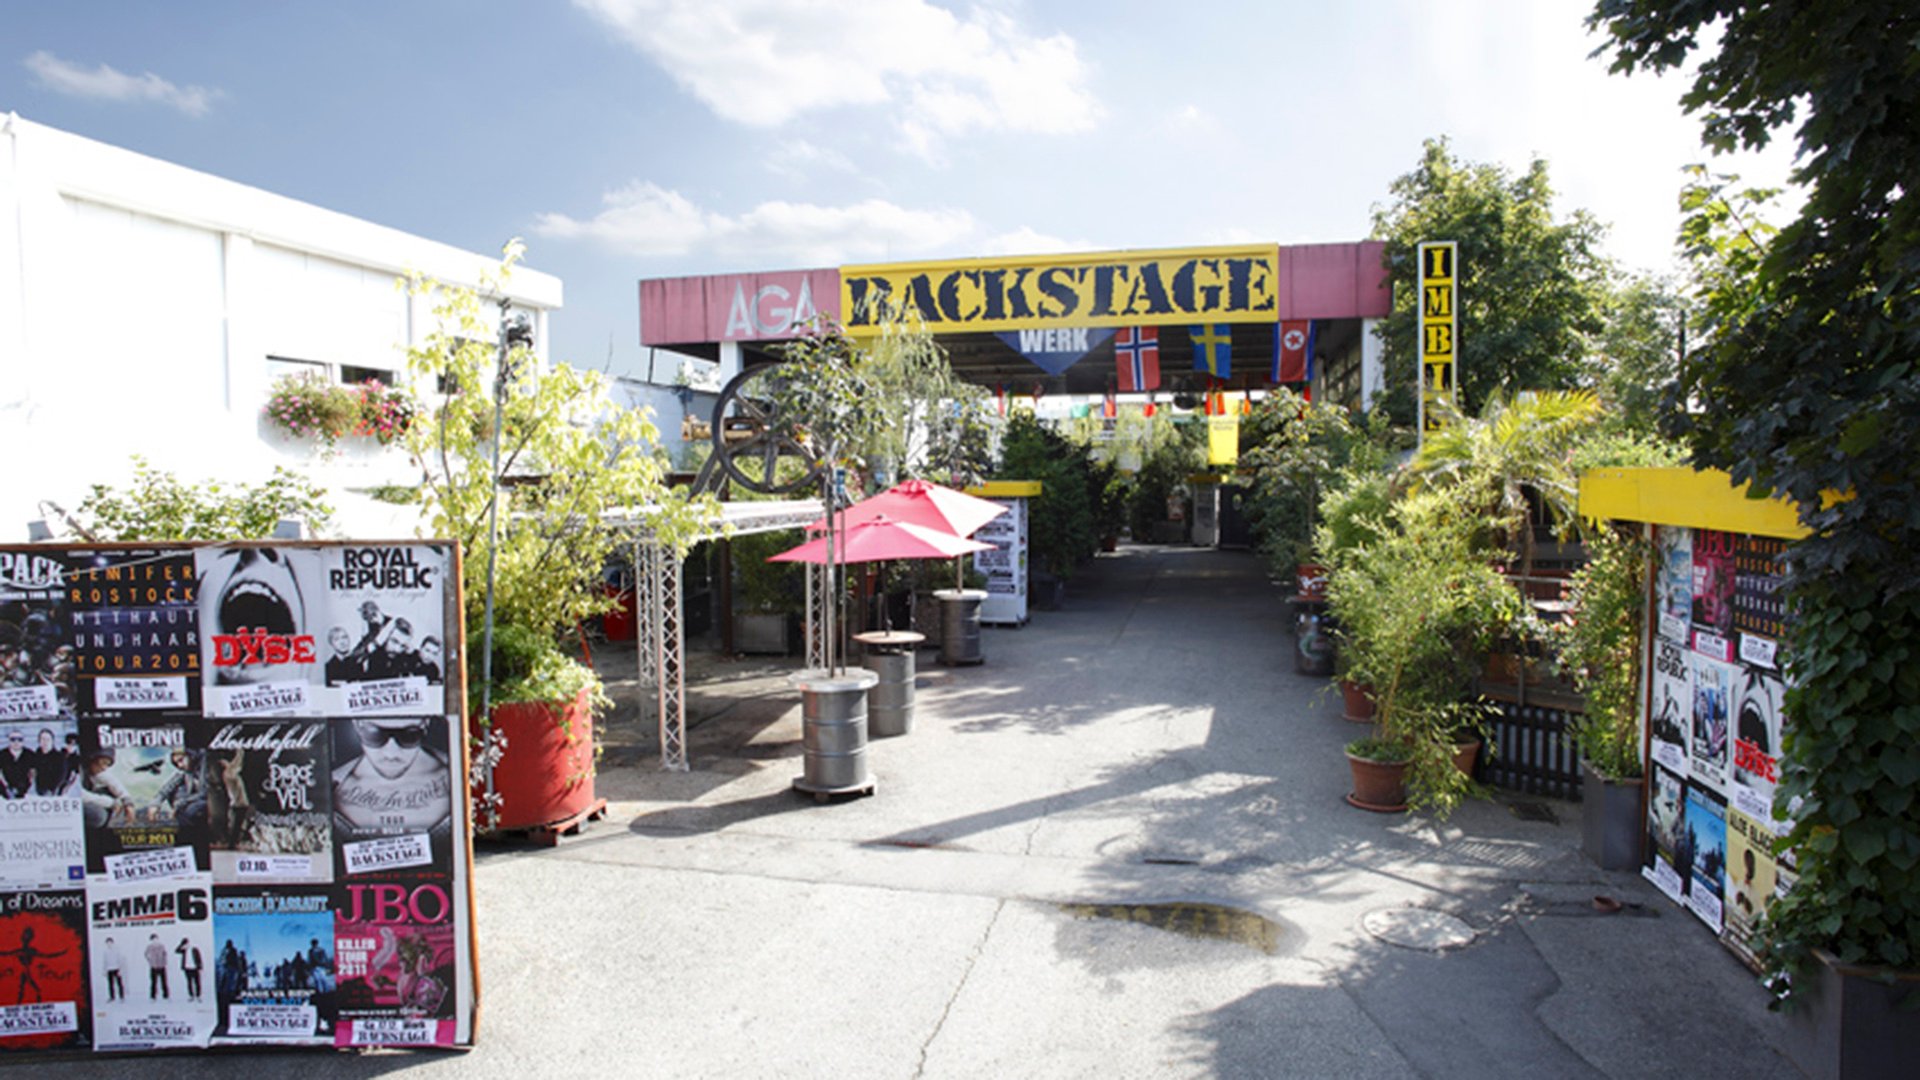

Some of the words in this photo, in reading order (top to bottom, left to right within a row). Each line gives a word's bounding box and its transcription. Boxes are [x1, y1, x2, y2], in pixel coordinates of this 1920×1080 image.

[845, 259, 1275, 327] BACKSTAGE
[725, 275, 820, 337] AGA
[1018, 328, 1090, 353] WERK
[343, 547, 418, 568] ROYAL
[330, 566, 433, 589] REPUBLIC
[71, 588, 194, 603] ROSTOCK
[6, 801, 80, 814] OCTOBER
[8, 893, 22, 909] of
[92, 892, 175, 922] EMMA
[176, 888, 209, 921] 6
